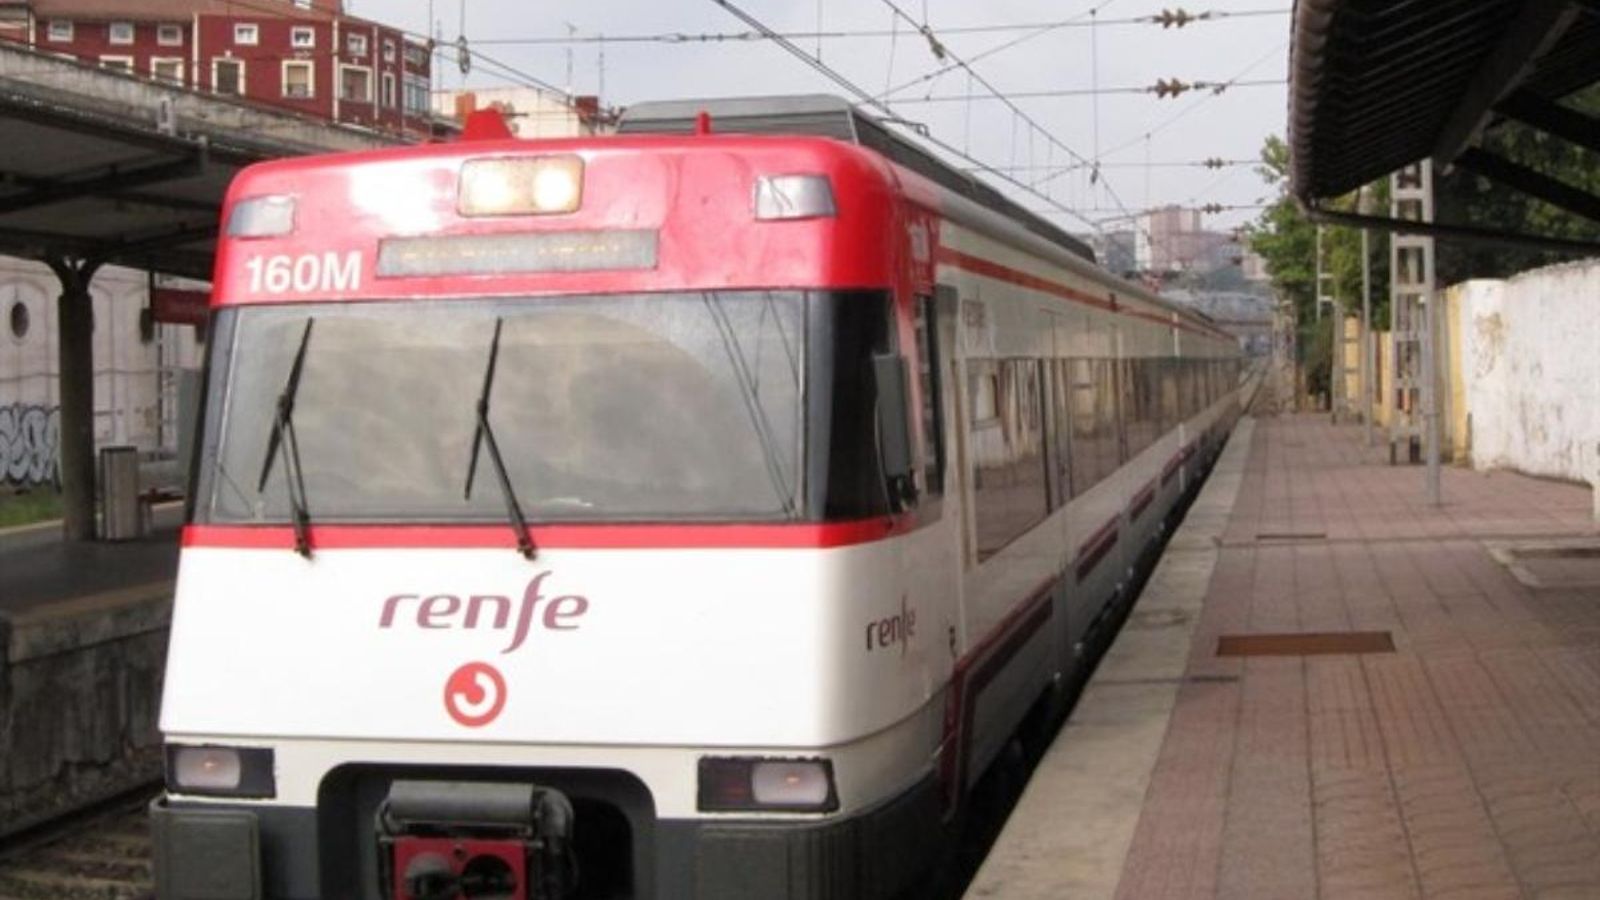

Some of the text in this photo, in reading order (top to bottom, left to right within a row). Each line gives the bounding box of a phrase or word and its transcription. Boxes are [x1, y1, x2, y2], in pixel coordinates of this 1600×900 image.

[246, 251, 362, 293] 160M
[378, 570, 590, 654] renfe
[866, 594, 917, 656] renfe
